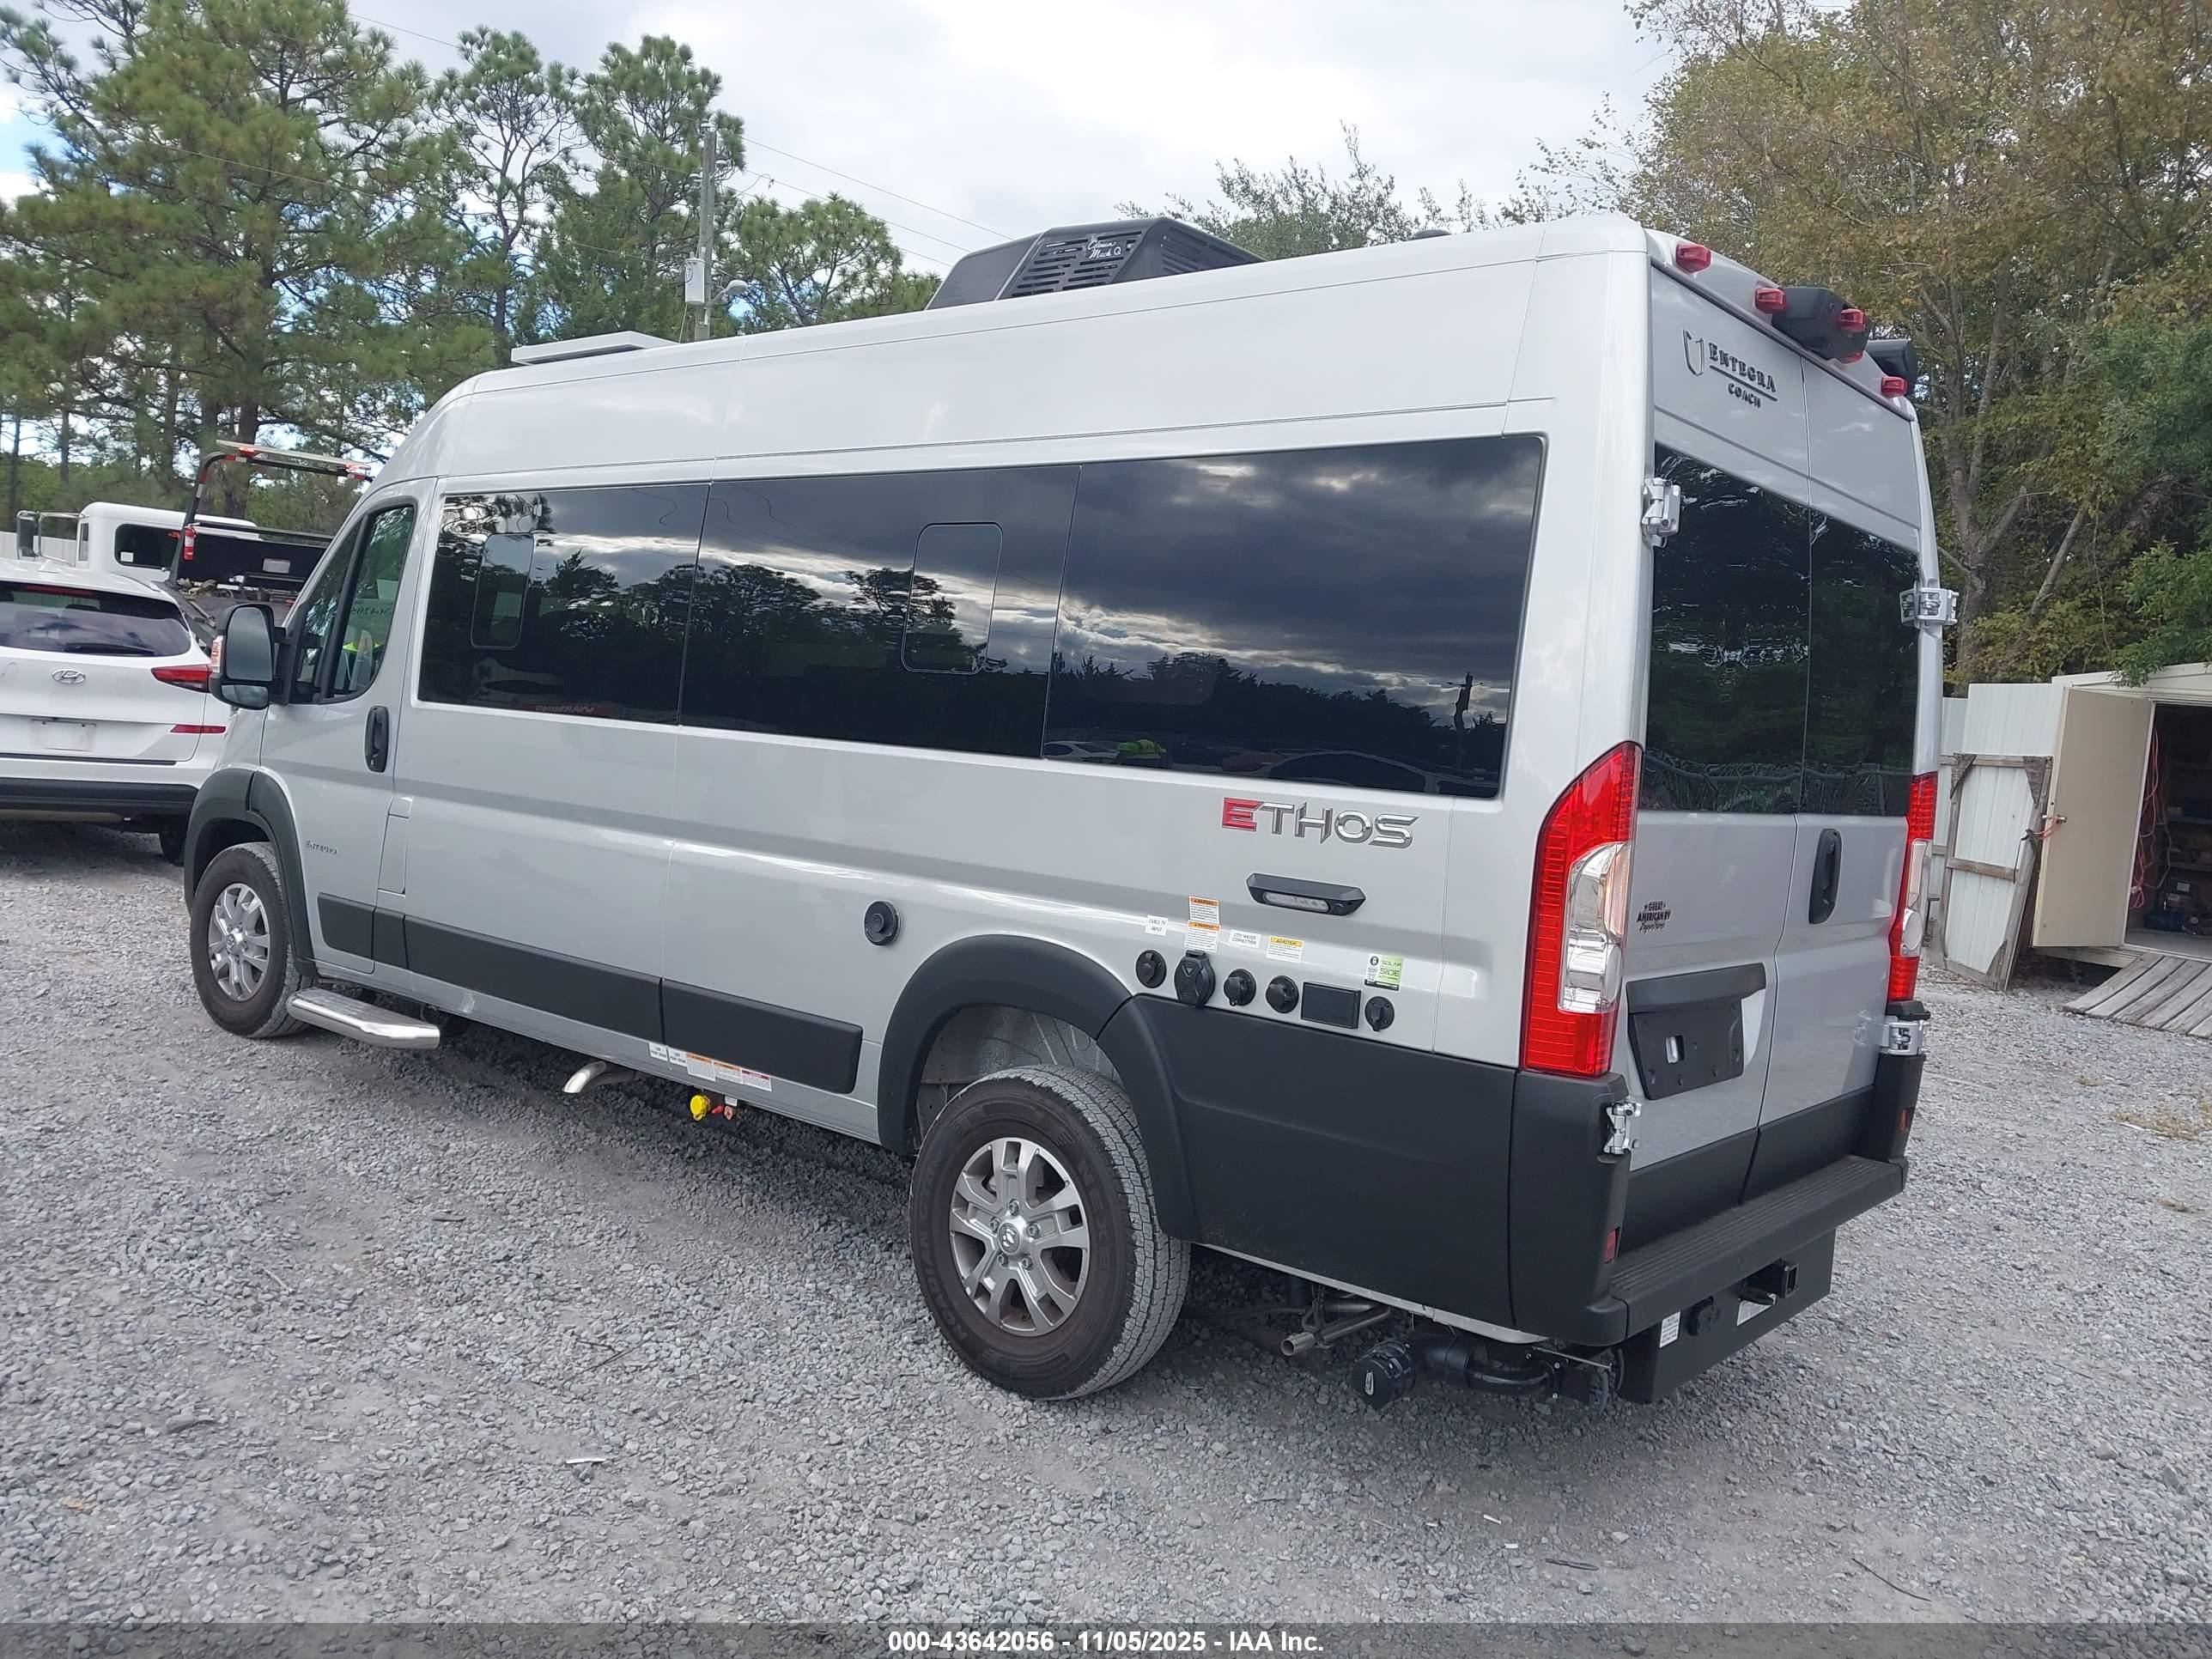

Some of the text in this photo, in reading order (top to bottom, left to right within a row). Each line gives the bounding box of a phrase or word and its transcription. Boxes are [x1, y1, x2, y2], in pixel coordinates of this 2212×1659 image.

[1708, 343, 1777, 393] ENTEGRA
[1728, 383, 1761, 409] COACH
[1222, 797, 1420, 849] ETHOS
[1379, 967, 1401, 977] SIDE
